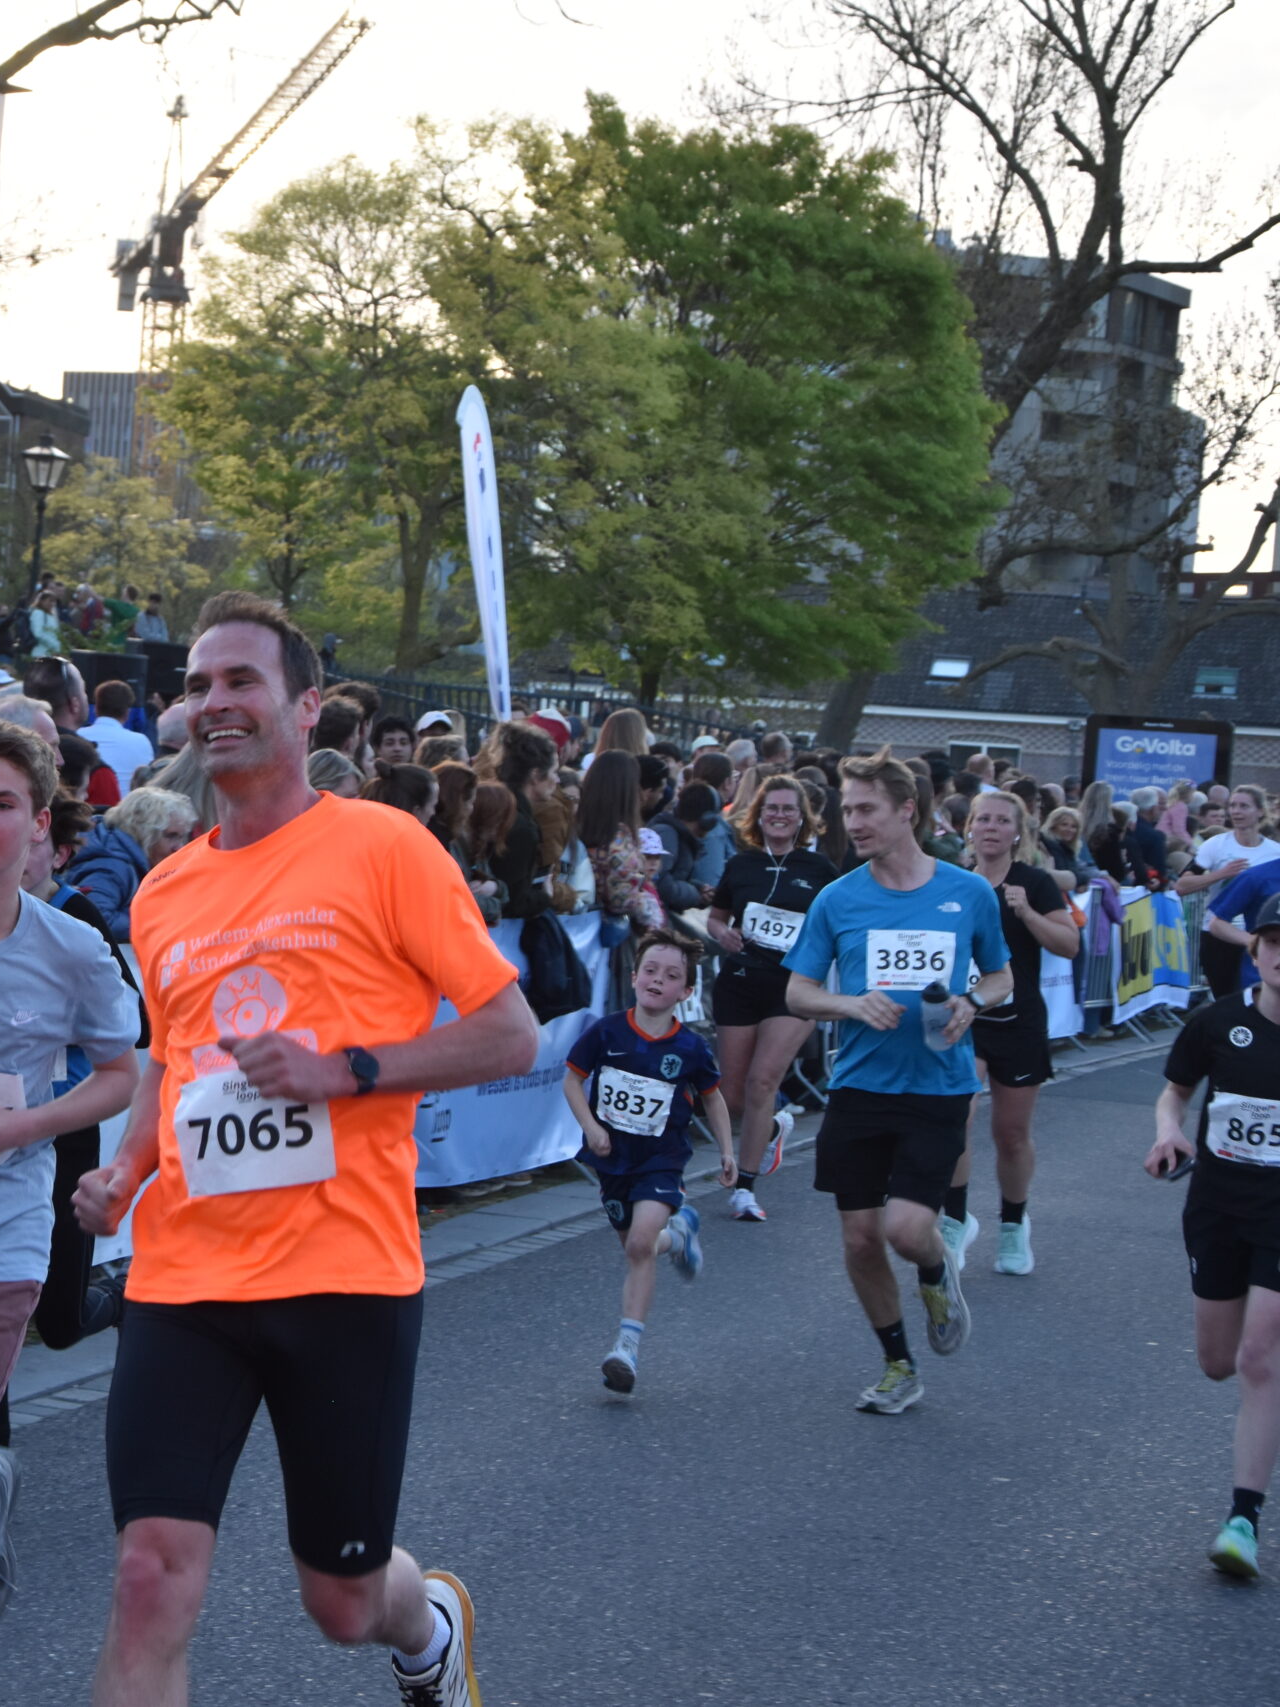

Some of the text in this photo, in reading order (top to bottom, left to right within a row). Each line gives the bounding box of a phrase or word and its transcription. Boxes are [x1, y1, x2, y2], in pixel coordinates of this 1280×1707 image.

[1115, 735, 1197, 756] GoVolta
[749, 917, 797, 939] 1497
[876, 948, 946, 972] 3836
[222, 1080, 257, 1092] Singe
[602, 1084, 665, 1118] 3837
[187, 1103, 313, 1160] 7065
